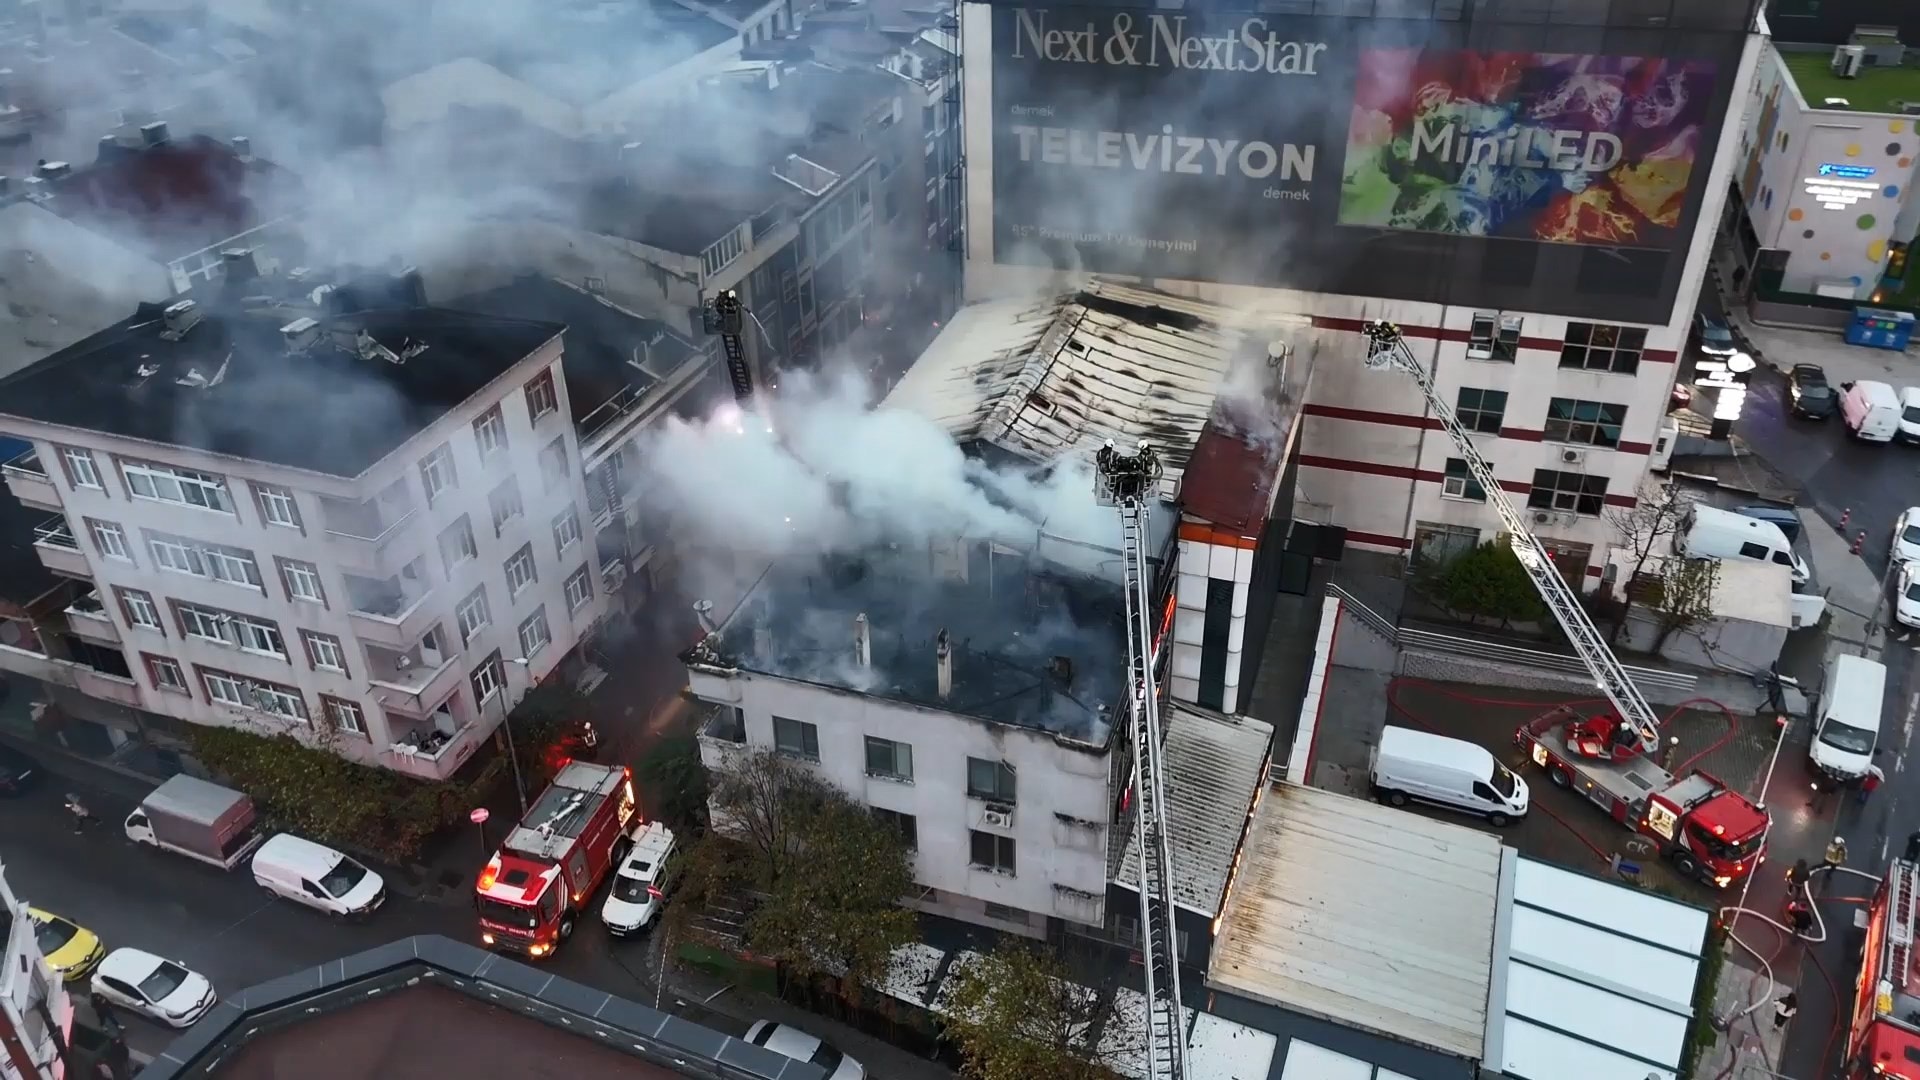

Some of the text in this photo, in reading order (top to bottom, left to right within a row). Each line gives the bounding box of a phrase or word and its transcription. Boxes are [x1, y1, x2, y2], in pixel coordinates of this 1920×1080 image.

[1011, 8, 1099, 64] Next
[1103, 12, 1143, 66] &
[1011, 104, 1054, 117] demek
[1011, 123, 1316, 182] TELEVİZYON
[1409, 120, 1623, 172] MiniLED
[1263, 186, 1311, 200] demek
